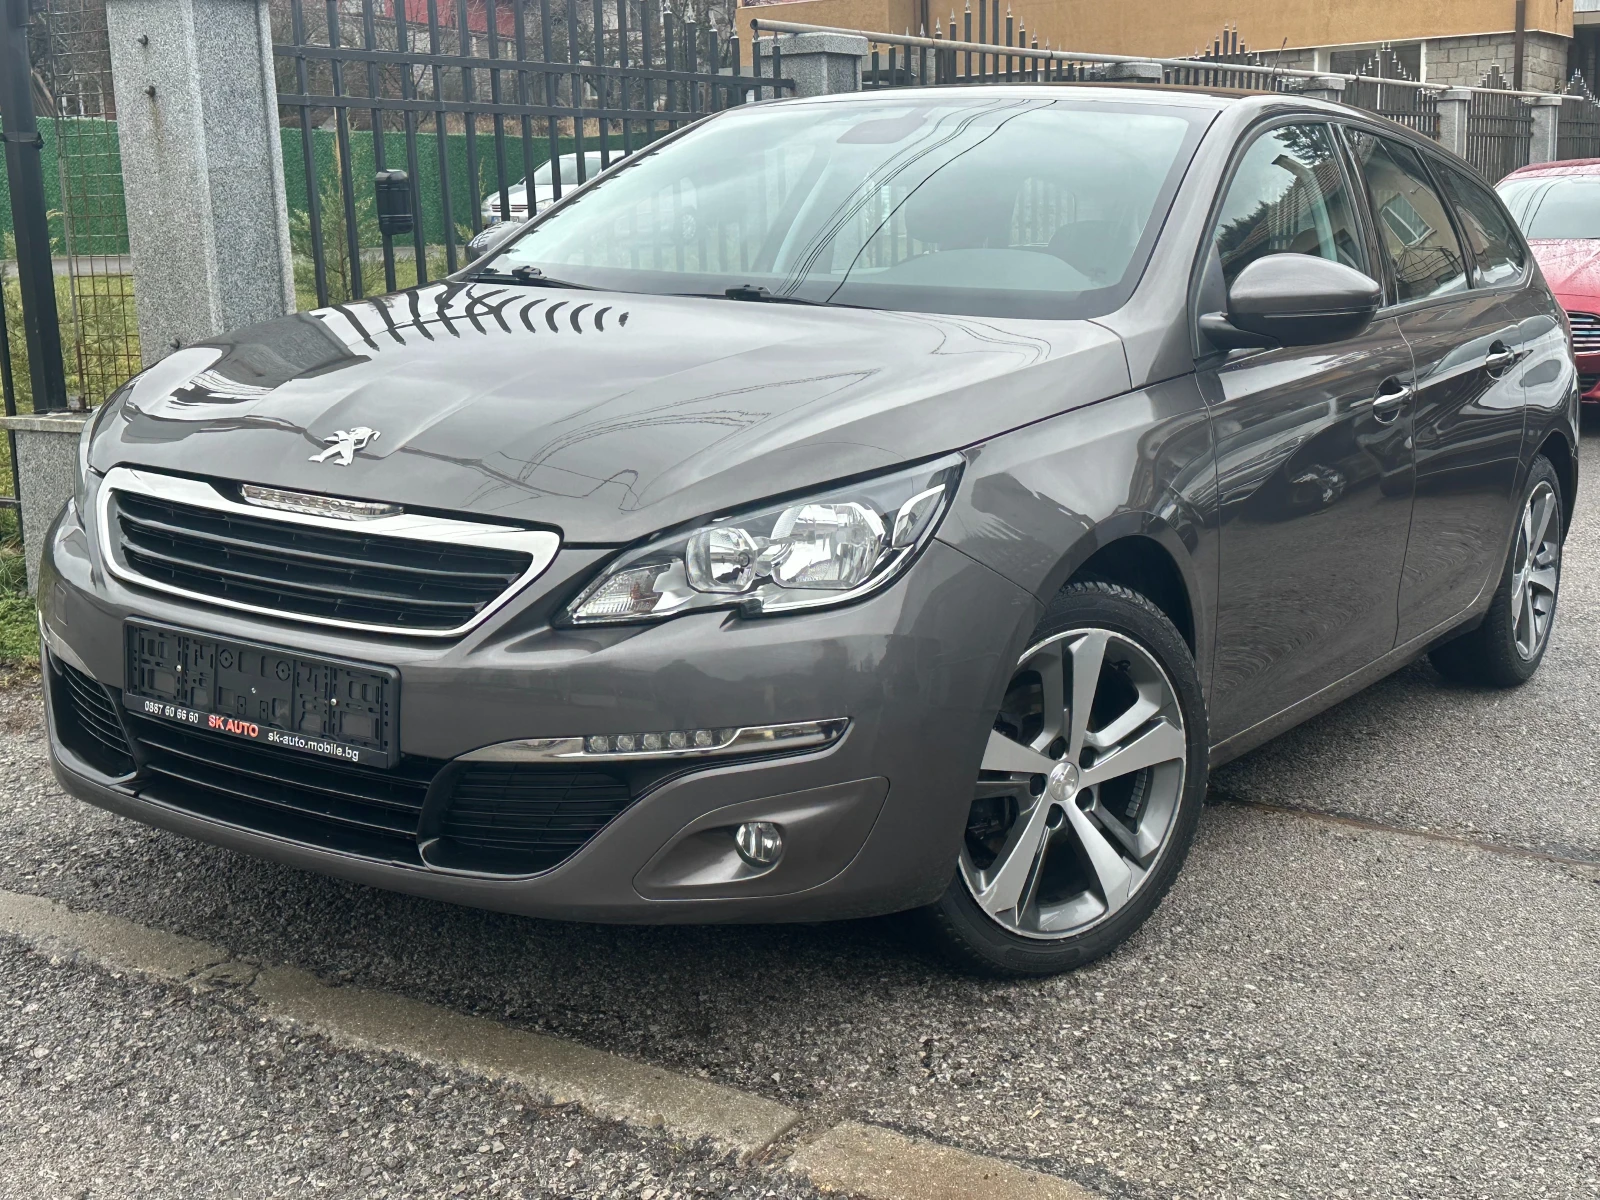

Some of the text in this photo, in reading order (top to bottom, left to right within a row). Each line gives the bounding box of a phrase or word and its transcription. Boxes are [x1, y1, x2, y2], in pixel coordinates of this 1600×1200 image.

[164, 705, 175, 717] 60
[176, 709, 187, 720] 66
[188, 711, 199, 723] 60
[208, 714, 259, 738] SK AUTO
[267, 731, 360, 762] sk-auto.mobile.bg
